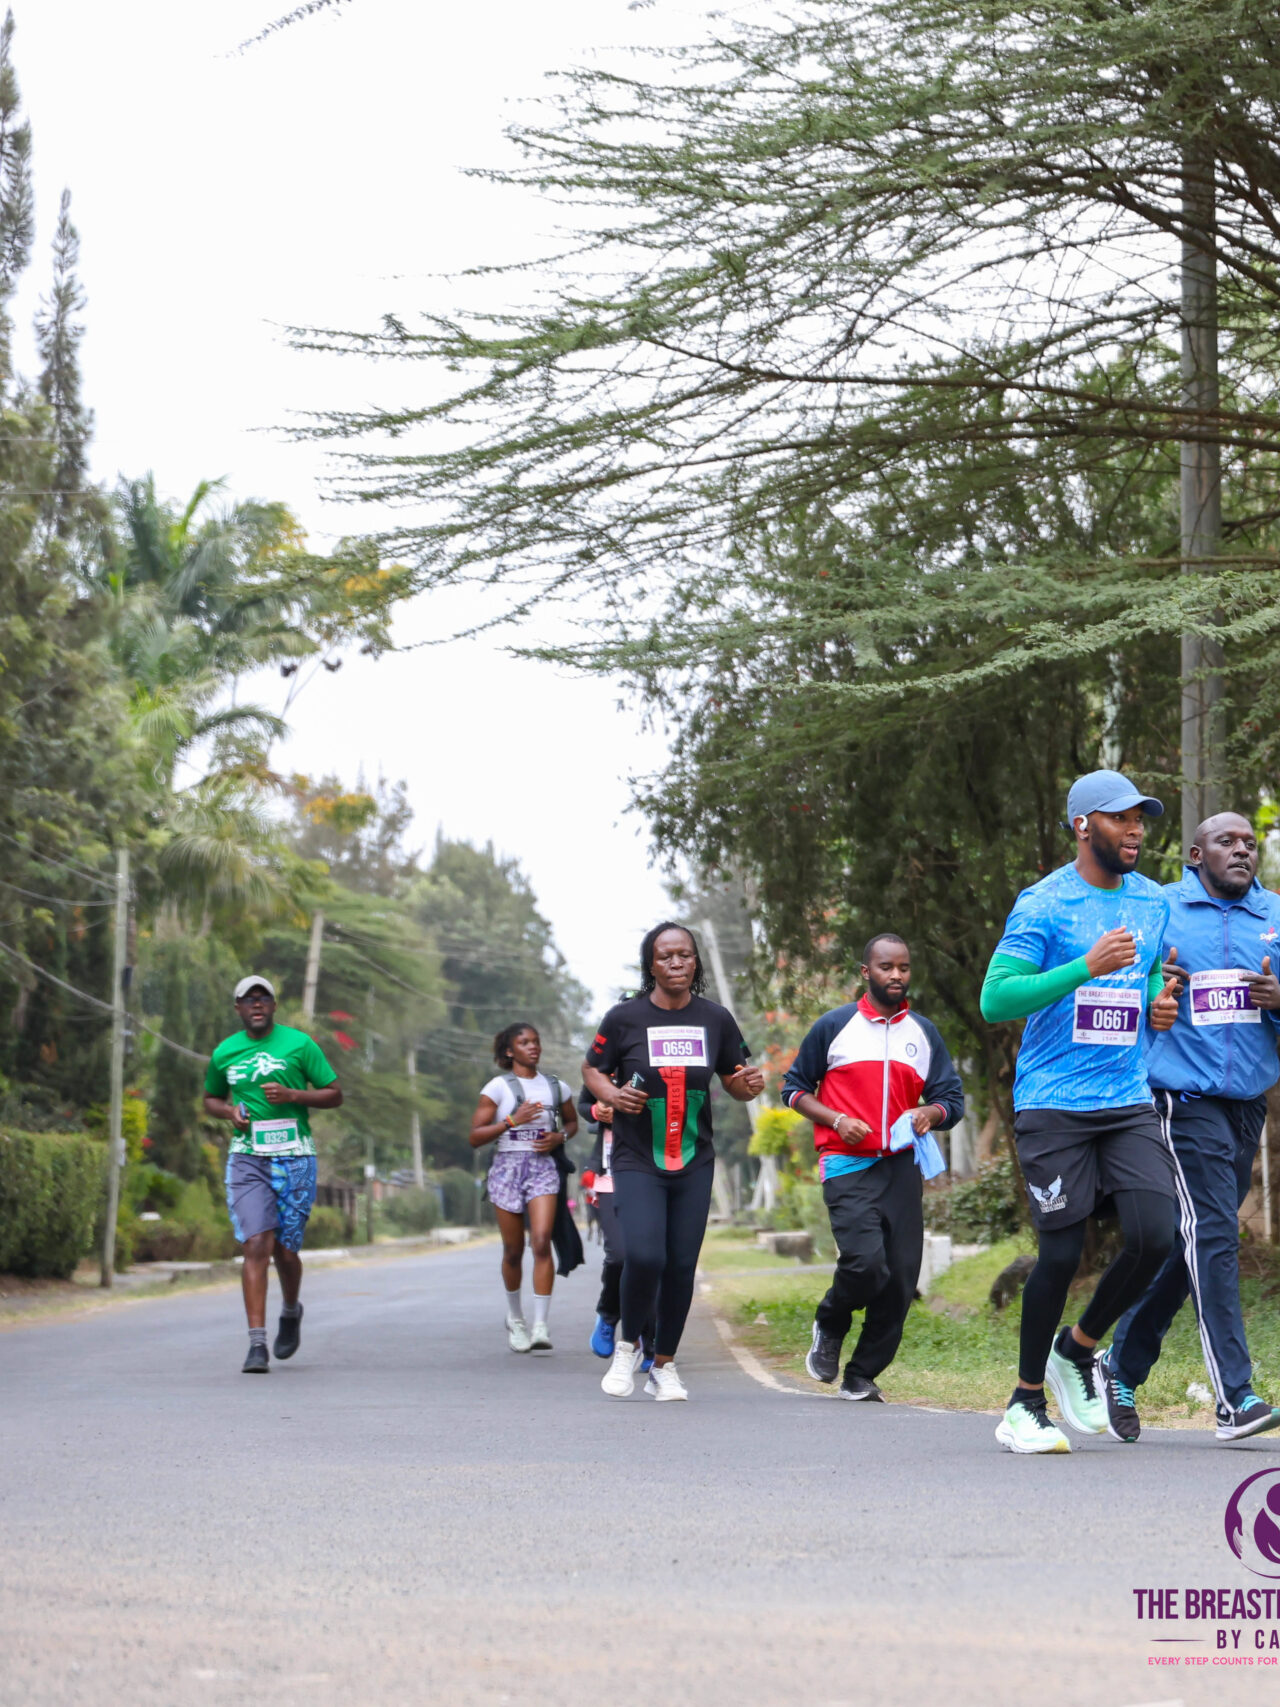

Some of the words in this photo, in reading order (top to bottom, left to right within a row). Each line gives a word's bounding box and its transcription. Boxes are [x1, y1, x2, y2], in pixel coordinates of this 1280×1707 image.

[1208, 989, 1245, 1010] 0641
[1092, 1008, 1129, 1030] 0661
[662, 1041, 693, 1056] 0659
[263, 1130, 288, 1144] 0329
